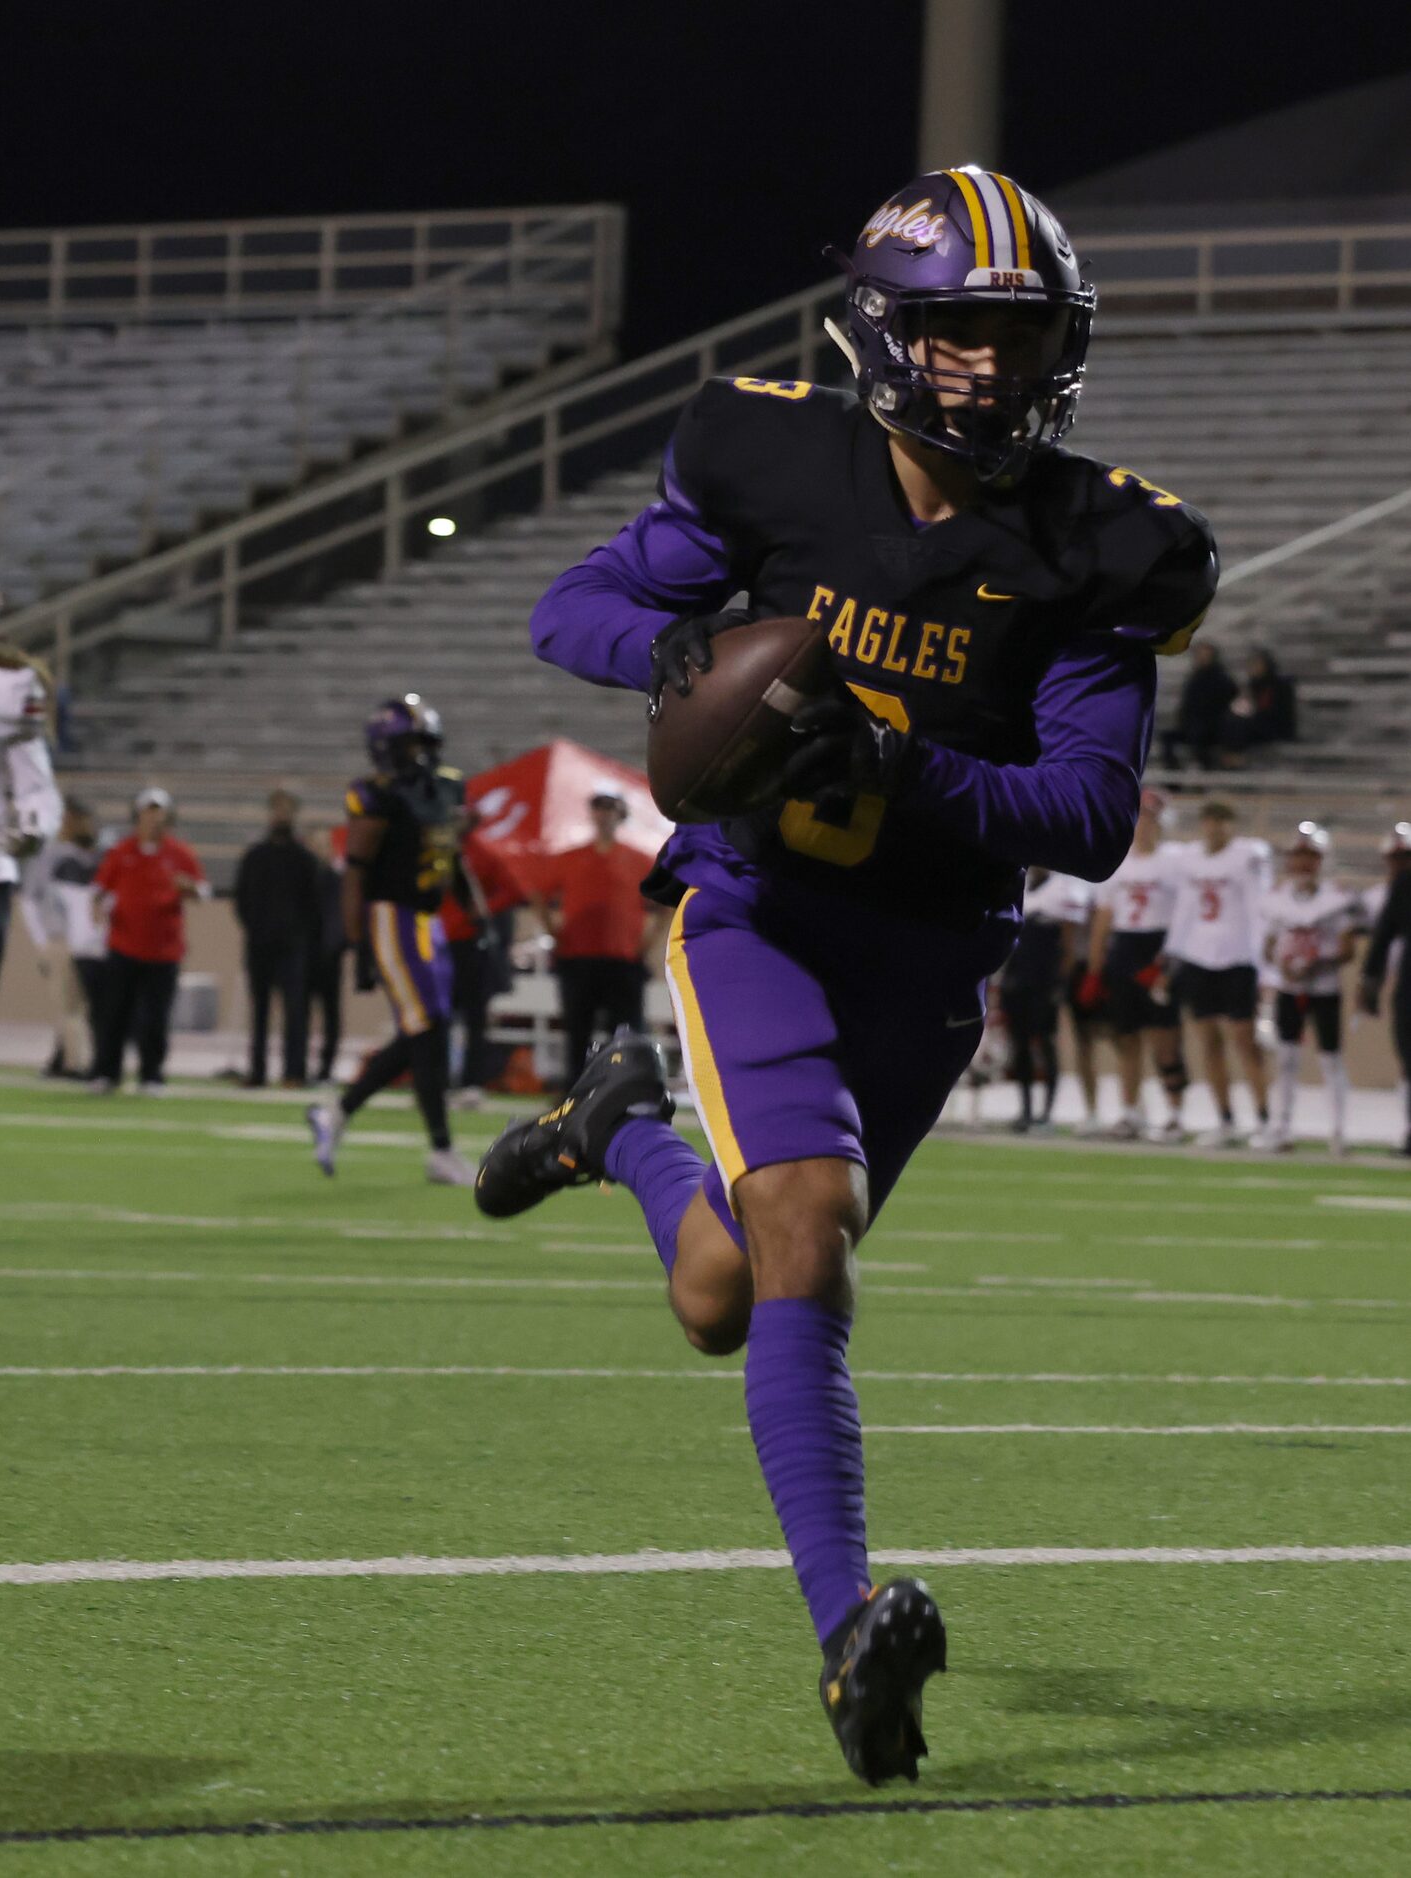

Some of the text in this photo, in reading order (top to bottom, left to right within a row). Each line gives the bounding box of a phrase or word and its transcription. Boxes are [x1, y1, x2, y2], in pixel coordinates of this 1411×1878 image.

[863, 198, 946, 248] agles
[990, 271, 1025, 287] RHS
[807, 585, 971, 685] EAGLES
